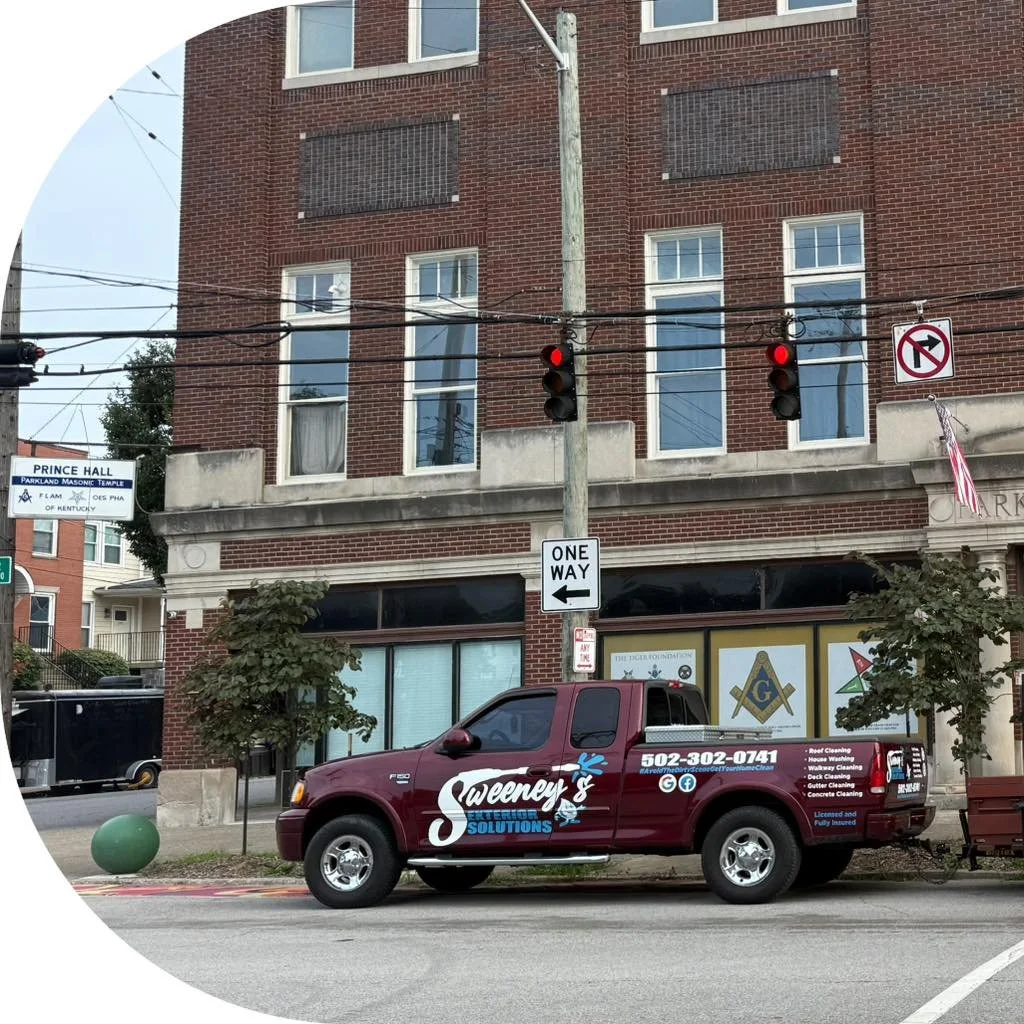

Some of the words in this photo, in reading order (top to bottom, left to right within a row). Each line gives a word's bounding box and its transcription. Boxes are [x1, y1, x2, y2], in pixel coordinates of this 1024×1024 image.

[33, 464, 78, 475] PRINCE
[83, 466, 113, 476] HALL
[21, 477, 59, 485] PARKLAND
[62, 478, 94, 486] MASONIC
[98, 479, 124, 487] TEMPLE
[552, 544, 589, 561] ONE
[550, 563, 590, 580] WAY
[824, 747, 852, 755] Cleaning
[641, 750, 778, 767] 502-302-0741
[828, 755, 855, 763] Washing
[835, 764, 863, 772] Cleaning
[823, 773, 851, 781] Cleaning
[828, 782, 855, 790] Cleaning
[835, 791, 863, 799] Cleaning
[428, 768, 595, 847] Sweeney's
[467, 809, 538, 820] EXTERIOR
[467, 820, 553, 834] SOLUTIONS
